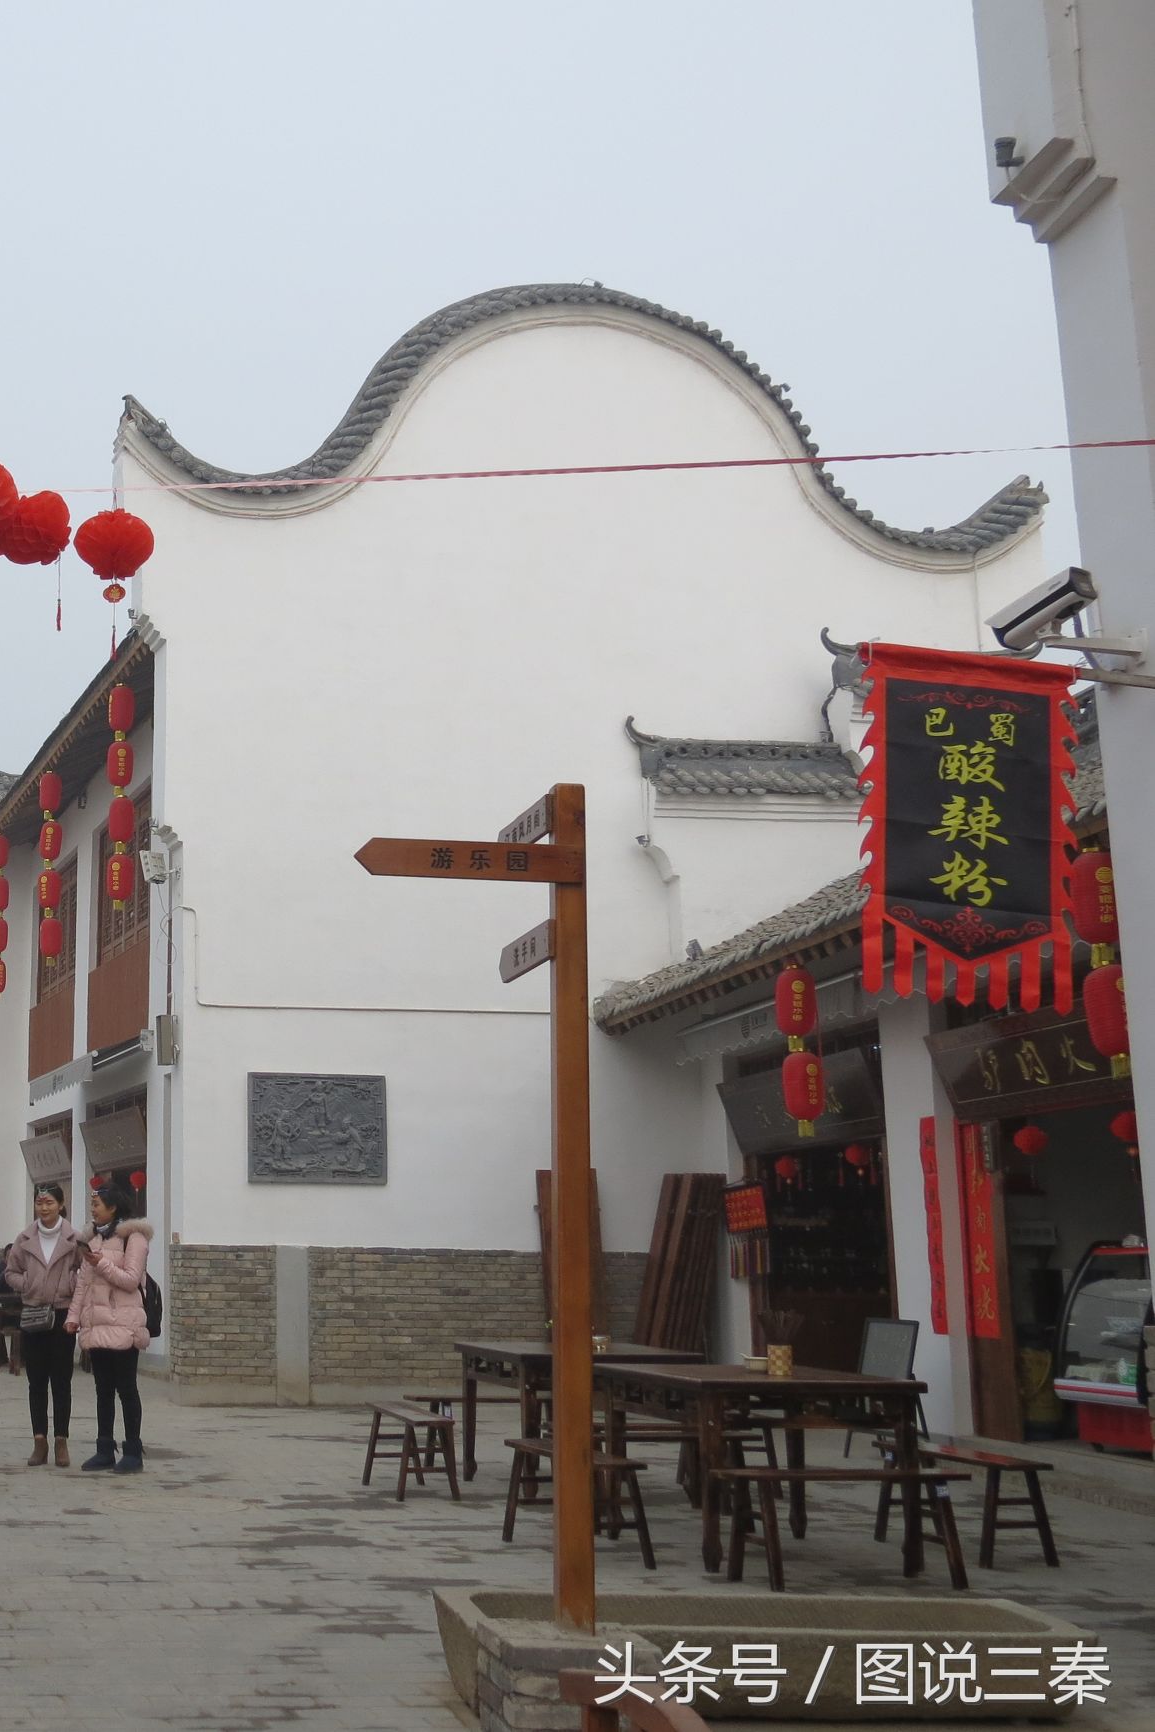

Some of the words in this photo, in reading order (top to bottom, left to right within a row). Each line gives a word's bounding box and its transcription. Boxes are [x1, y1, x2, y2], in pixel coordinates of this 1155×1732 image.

[924, 708, 1016, 747] 巴蜀
[927, 741, 1009, 907] 酸辣粉
[430, 848, 528, 871] 游乐园
